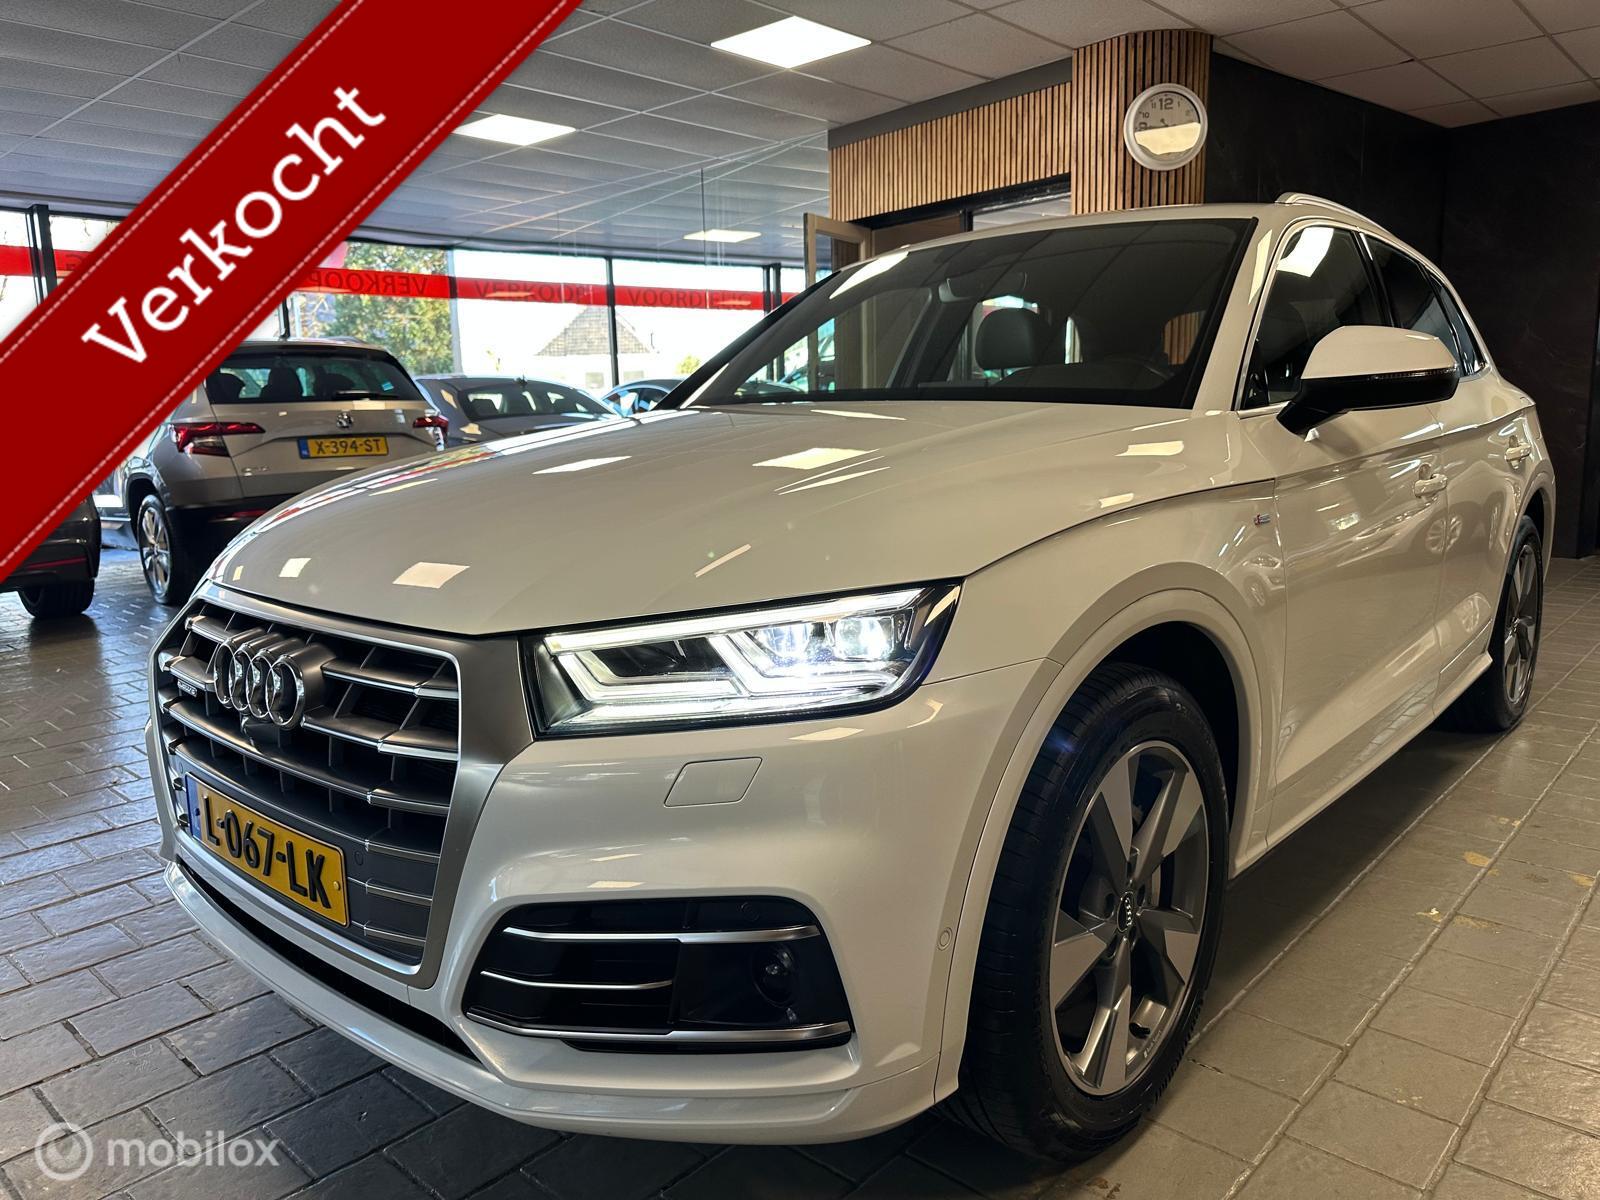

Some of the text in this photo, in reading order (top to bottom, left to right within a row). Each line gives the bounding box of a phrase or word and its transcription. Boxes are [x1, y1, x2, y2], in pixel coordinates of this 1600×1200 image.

[1159, 98, 1173, 110] 12
[315, 439, 381, 454] X-394-ST
[202, 795, 332, 909] L-067-LK
